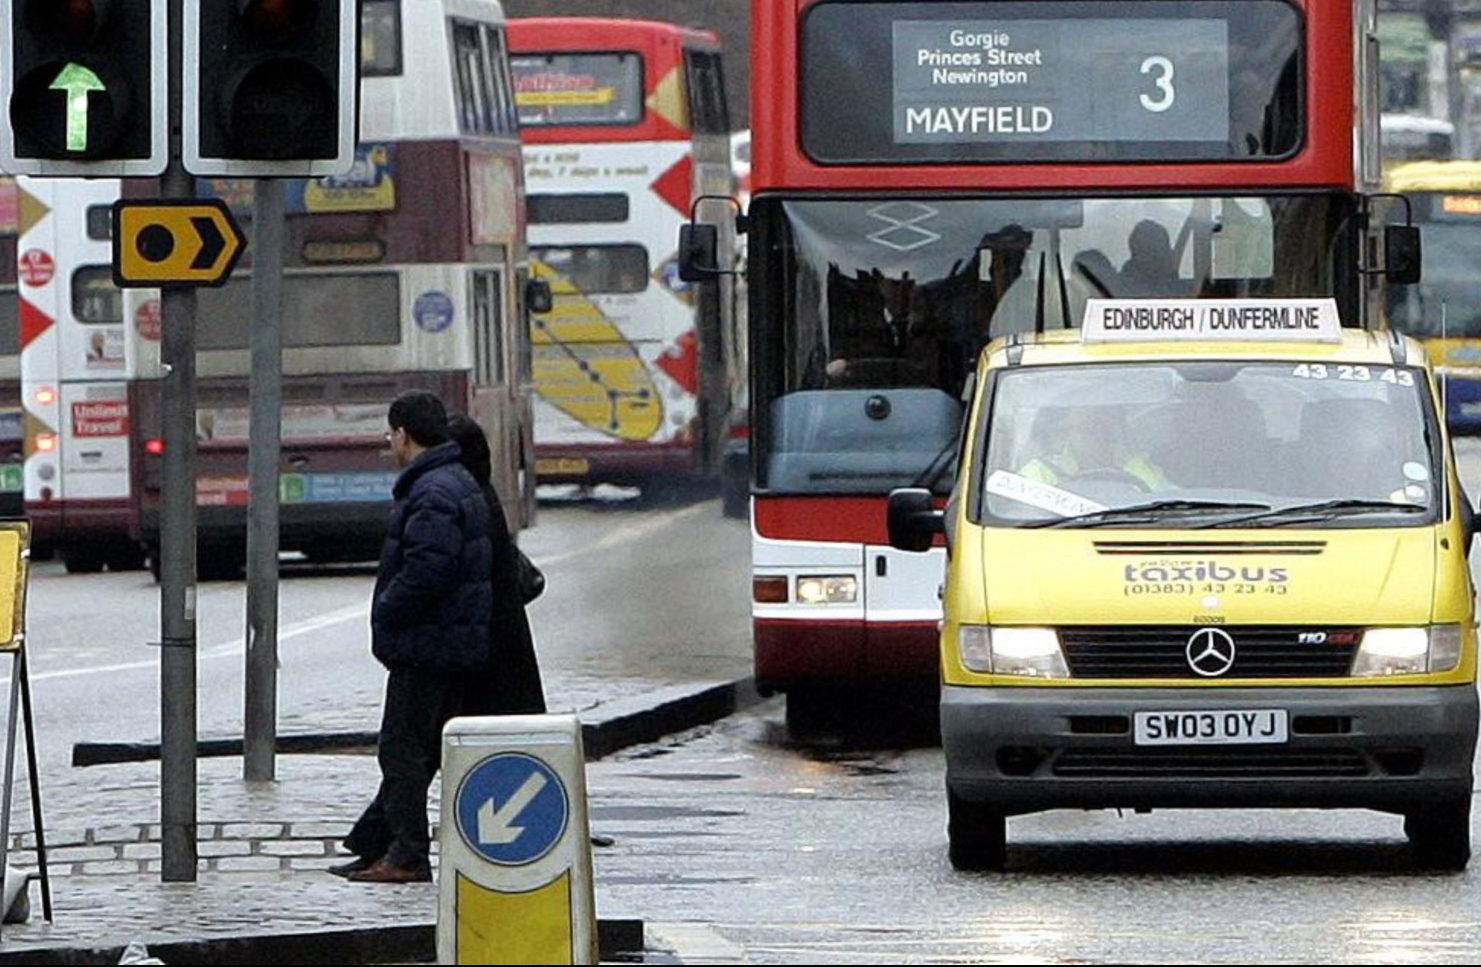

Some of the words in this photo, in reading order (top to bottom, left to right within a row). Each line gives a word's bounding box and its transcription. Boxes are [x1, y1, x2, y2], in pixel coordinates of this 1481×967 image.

[950, 30, 1009, 48] Gorgie
[918, 50, 981, 65] Princes
[988, 50, 1041, 65] Street
[933, 69, 1027, 87] Newington
[1140, 56, 1175, 111] 3
[906, 107, 1052, 133] MAYFIELD
[1103, 308, 1194, 330] EDINBURGH
[1210, 307, 1320, 330] DUNFERMLINE
[1293, 364, 1328, 379] 43
[1338, 366, 1370, 380] 23
[1381, 369, 1414, 386] 43
[1125, 562, 1288, 582] taxibus
[1124, 584, 1194, 595] (01383)
[1202, 584, 1225, 593] 43
[1234, 584, 1255, 593] 23
[1265, 584, 1287, 595] 43
[1146, 714, 1215, 738] SW03
[1224, 713, 1276, 737] OYJ
